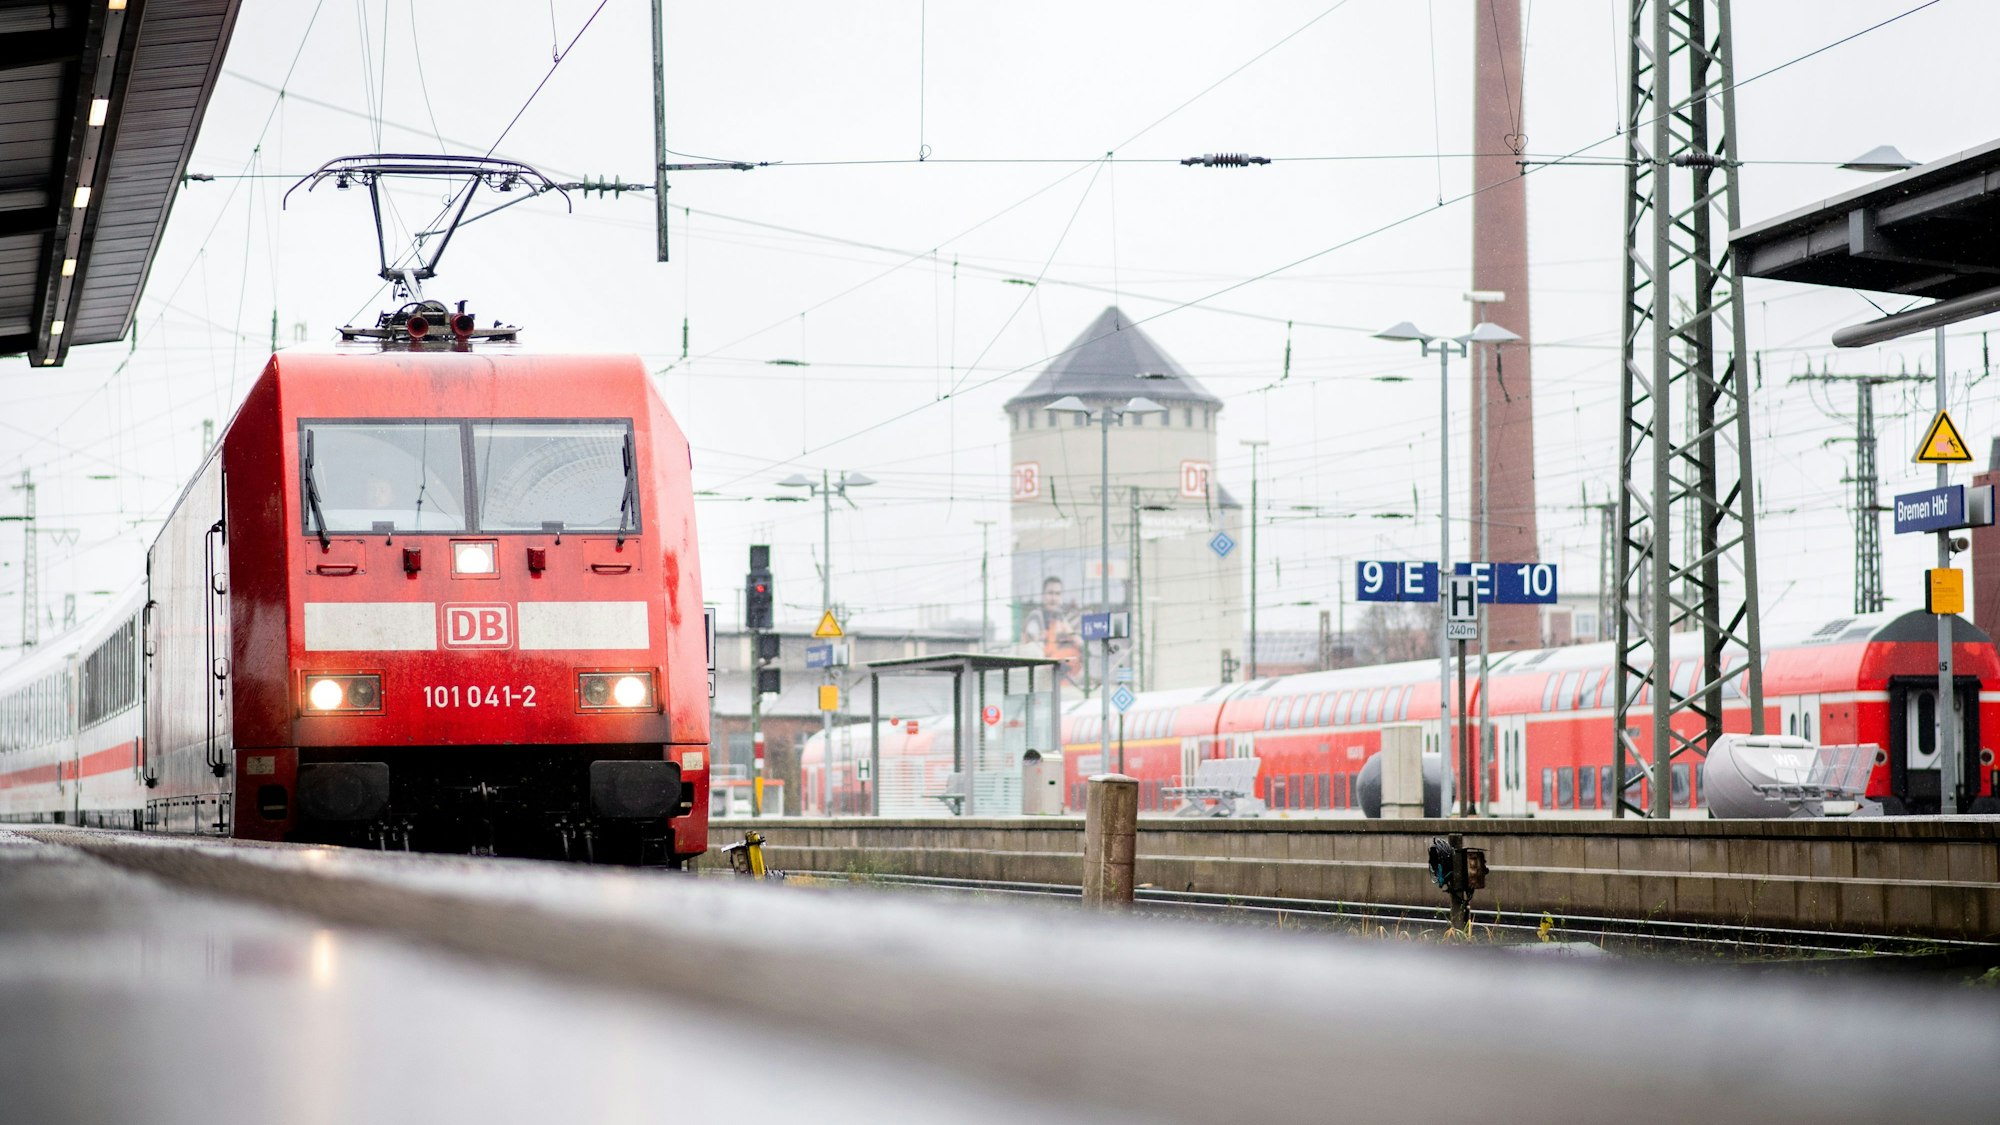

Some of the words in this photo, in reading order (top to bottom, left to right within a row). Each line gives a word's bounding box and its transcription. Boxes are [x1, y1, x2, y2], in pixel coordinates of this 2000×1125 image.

[1897, 498, 1930, 522] Bremen
[1932, 493, 1948, 517] Hbf
[1363, 561, 1384, 593] 9
[1404, 562, 1425, 594] E
[1470, 563, 1491, 595] E
[1517, 564, 1553, 597] 10
[1451, 580, 1475, 616] H
[451, 610, 504, 641] DB
[423, 685, 460, 708] 101
[467, 685, 537, 708] 041-2
[858, 759, 870, 778] H
